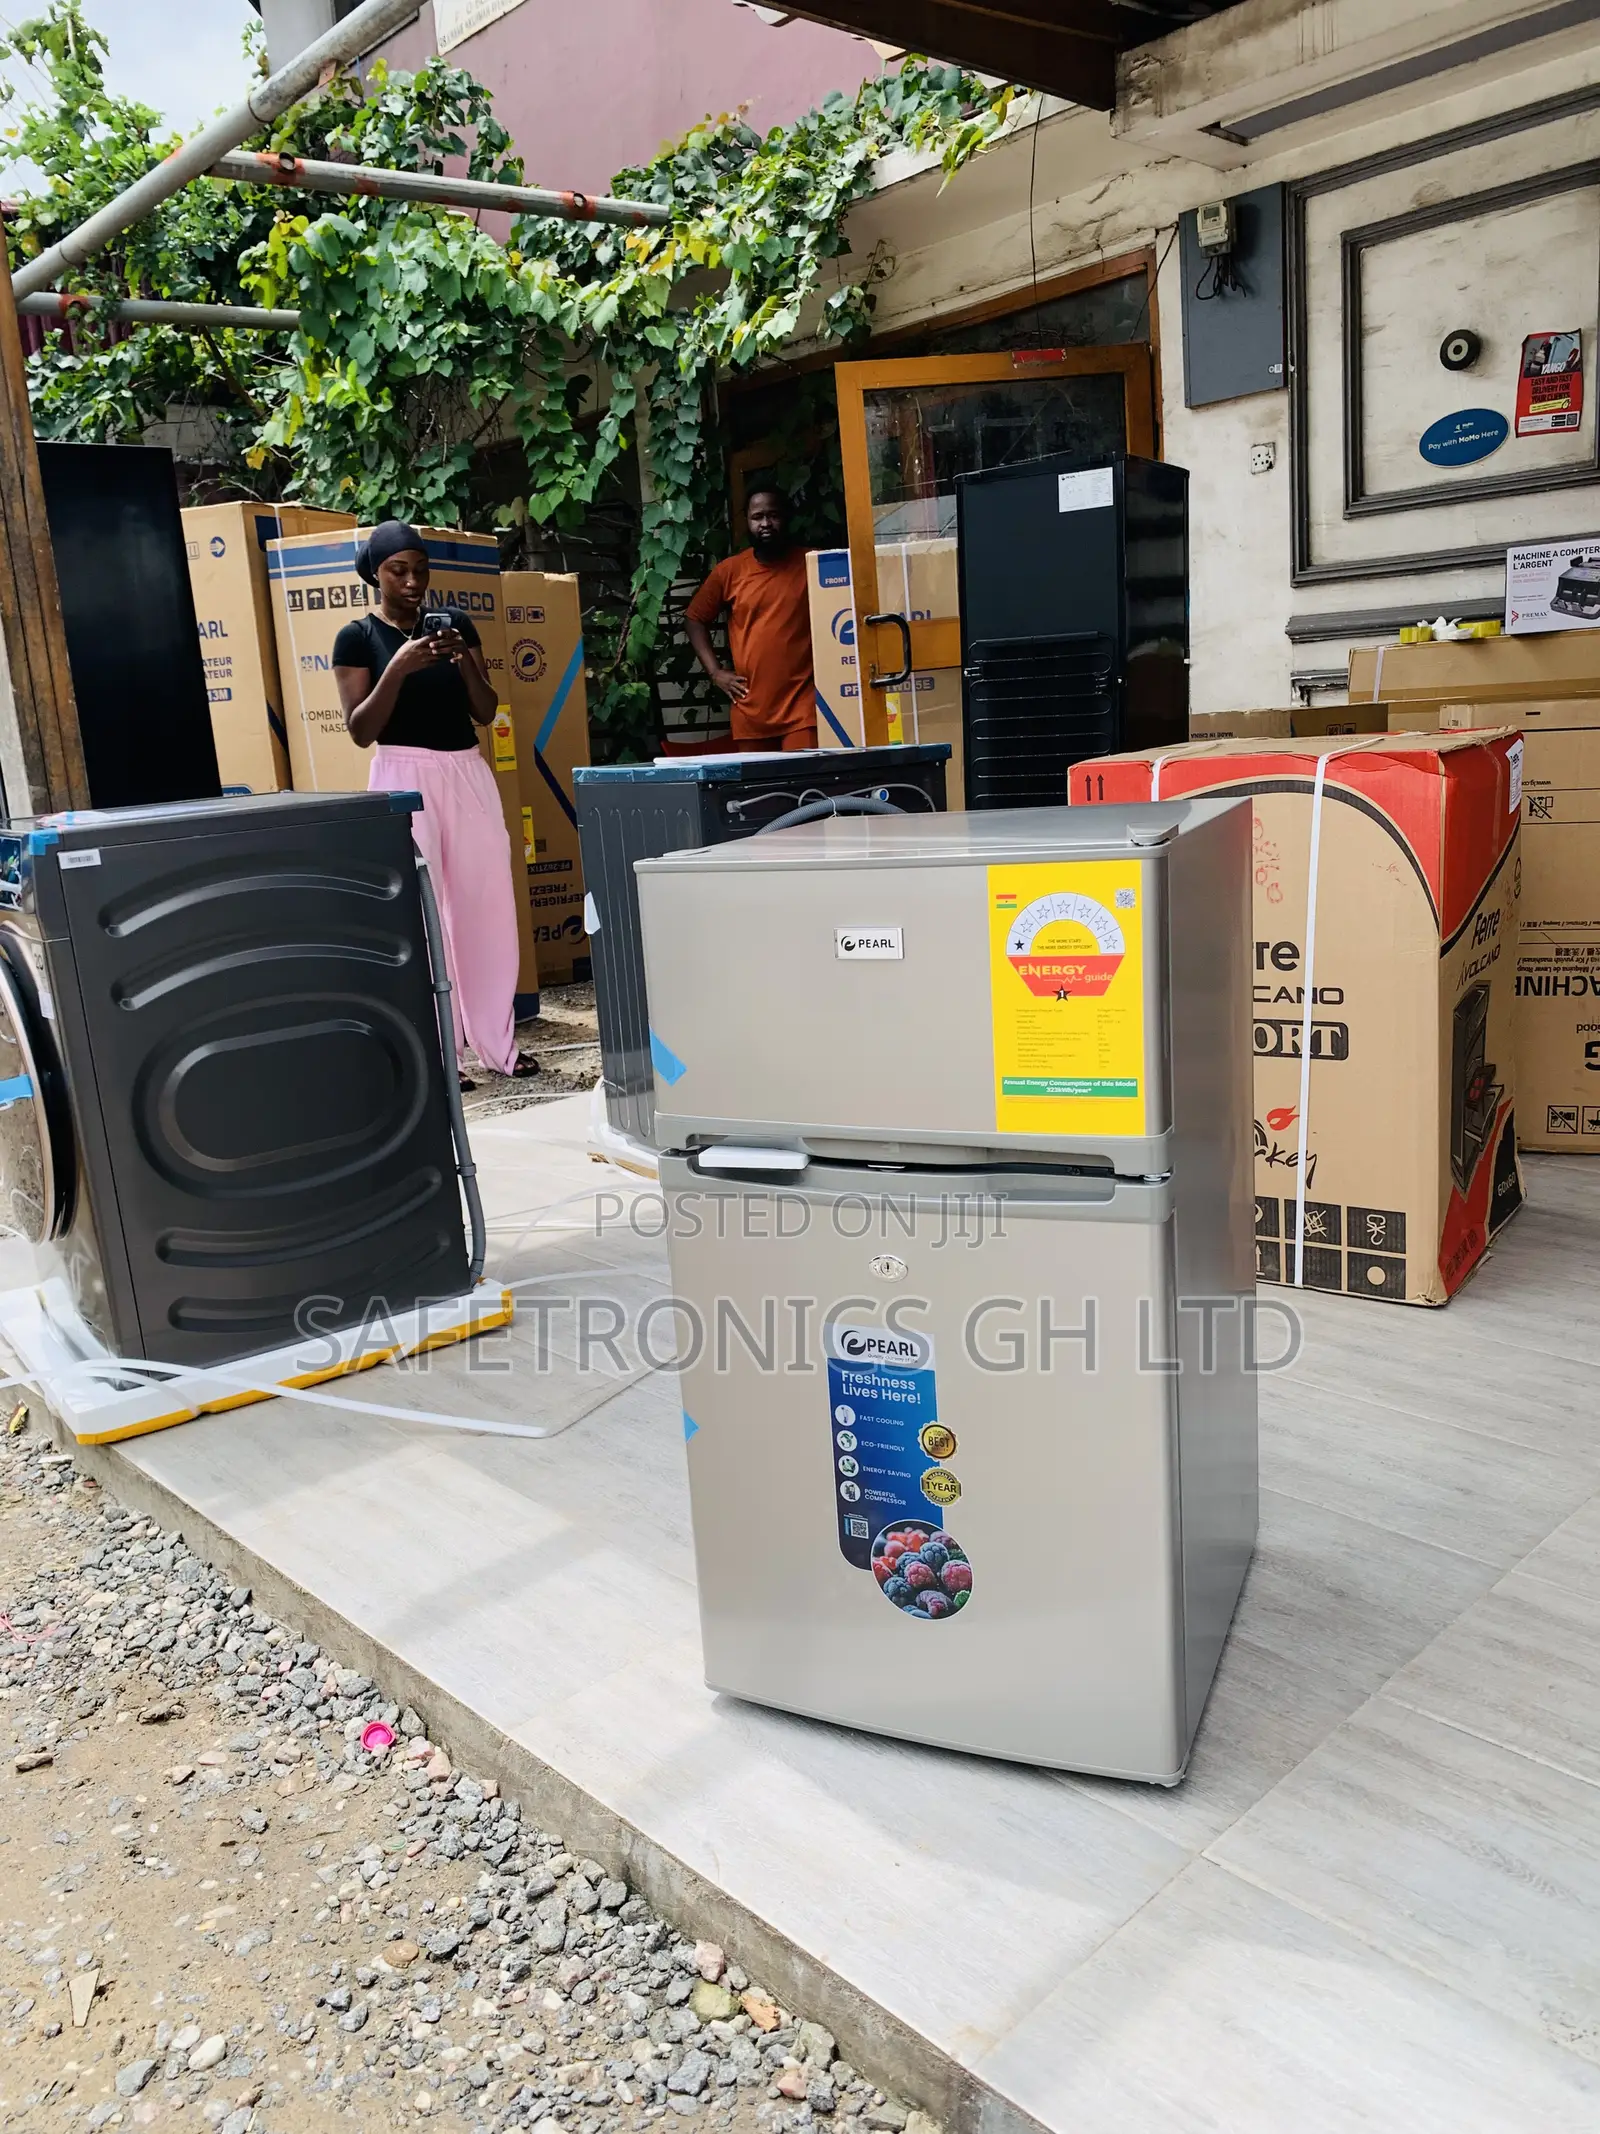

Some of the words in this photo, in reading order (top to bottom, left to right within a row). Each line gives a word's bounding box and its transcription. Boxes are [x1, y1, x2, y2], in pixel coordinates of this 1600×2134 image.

[1541, 361, 1566, 375] YANGO
[1442, 438, 1457, 447] with
[1459, 434, 1480, 443] MoMo
[1481, 429, 1499, 438] Here
[1513, 551, 1551, 561] MACHINE
[1560, 546, 1600, 557] COMPTER
[1513, 560, 1553, 570] L'ARGENT
[825, 577, 847, 585] FRONT
[430, 589, 495, 612] NASCO
[198, 619, 228, 639] ARL
[203, 656, 232, 667] ATEUR
[486, 658, 504, 670] DGE
[205, 668, 232, 679] ATEUR
[301, 709, 342, 722] COMBIN
[533, 925, 560, 943] PEA
[1471, 908, 1501, 950] Ferre
[858, 938, 895, 949] PEARL
[1255, 941, 1300, 972] re
[1463, 943, 1501, 982] VOLCANO
[1018, 963, 1087, 979] ENERGY
[1084, 971, 1113, 984] guide
[1253, 985, 1345, 1005] CANO
[1253, 1021, 1342, 1057] ORT
[1027, 1079, 1048, 1087] Energy
[1049, 1080, 1092, 1088] Consumption
[1264, 1141, 1317, 1190] key
[1497, 1171, 1516, 1197] 60x60
[866, 1338, 918, 1357] PEARL
[841, 1370, 916, 1391] Freshness
[842, 1383, 878, 1399] Lives
[881, 1389, 921, 1405] Here!
[875, 1417, 904, 1426] COOLING
[861, 1441, 906, 1452] ECO-FRIENDLY
[928, 1436, 950, 1449] BEST
[863, 1466, 886, 1475] ENERGY
[887, 1469, 911, 1478] SAVING
[864, 1488, 896, 1499] POWERFUL
[864, 1494, 907, 1506] COMPRESSOR
